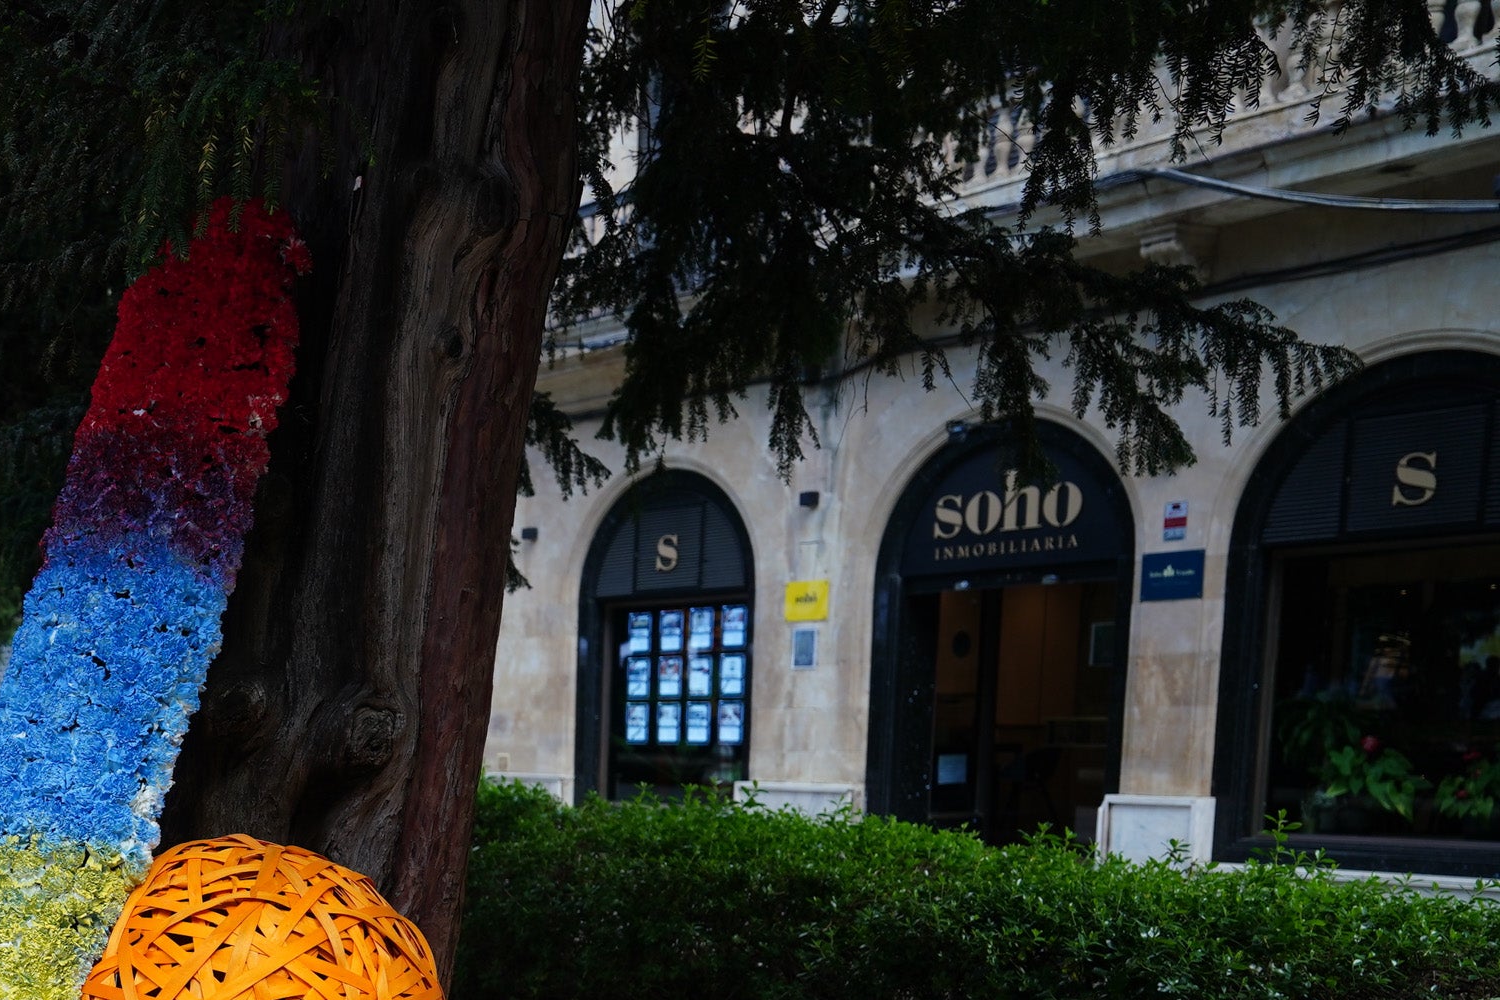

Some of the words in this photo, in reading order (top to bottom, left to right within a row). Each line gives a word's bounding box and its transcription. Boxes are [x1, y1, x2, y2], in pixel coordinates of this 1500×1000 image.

[1392, 450, 1437, 508] S
[933, 468, 1083, 540] soho
[655, 534, 678, 572] S
[934, 533, 1079, 561] INMOBILIARIA
